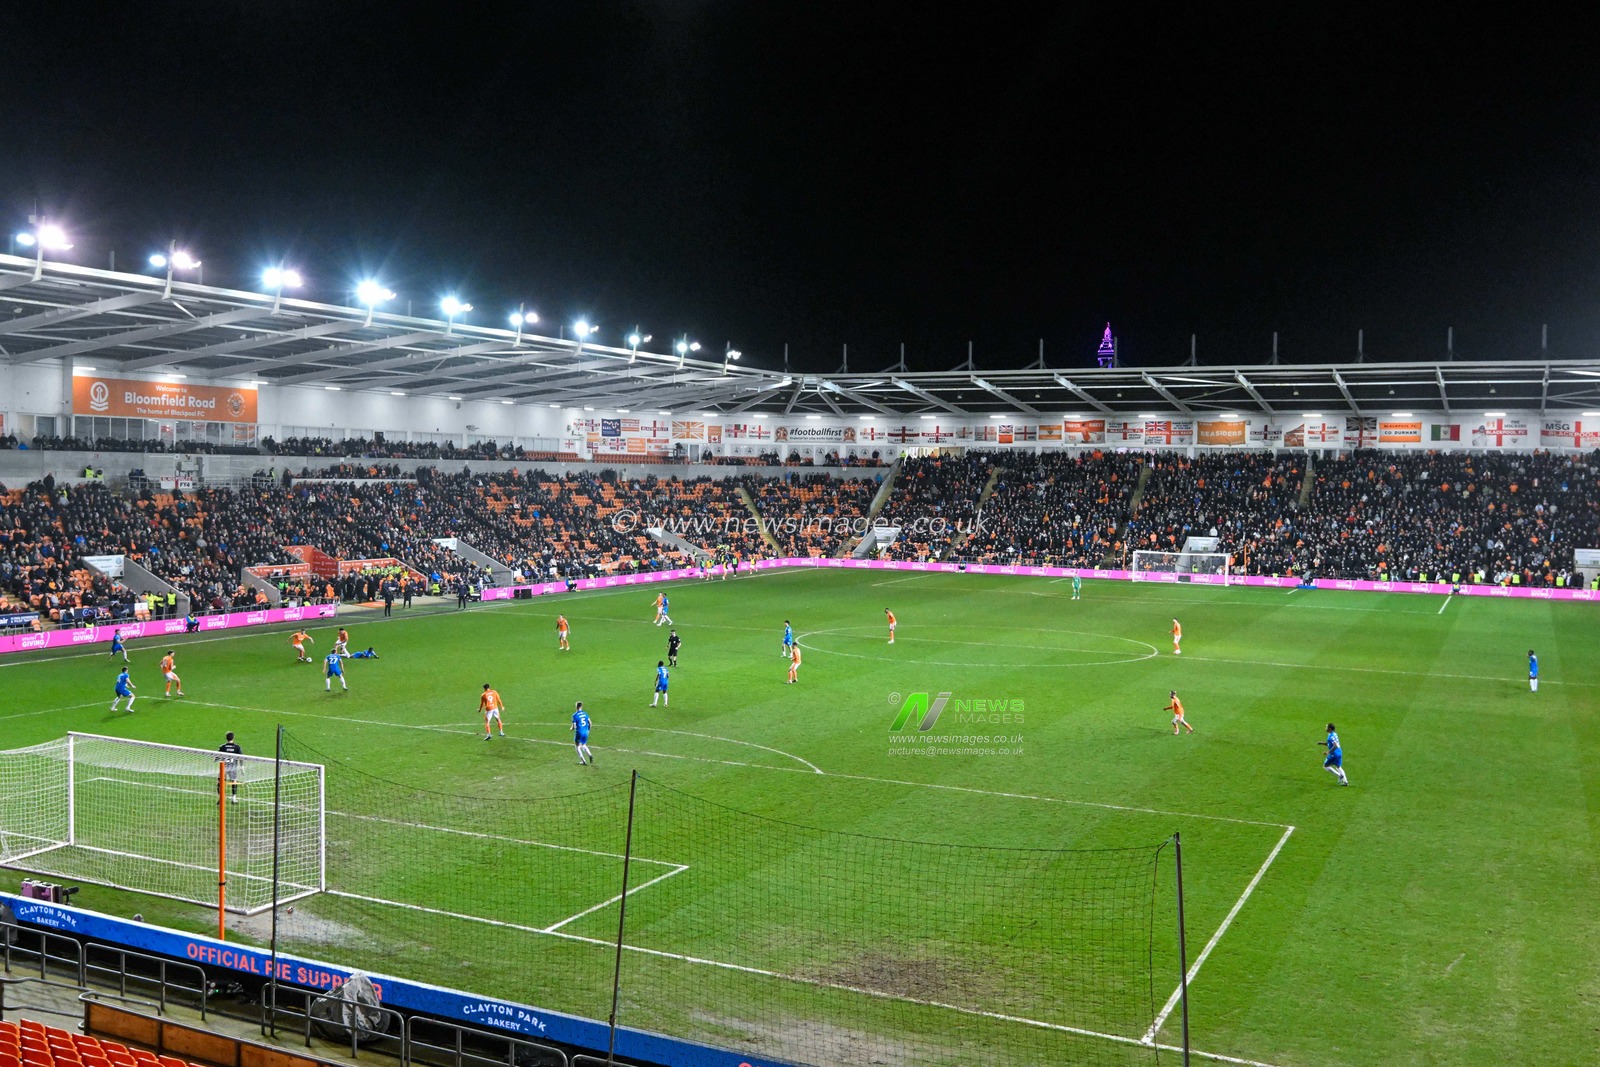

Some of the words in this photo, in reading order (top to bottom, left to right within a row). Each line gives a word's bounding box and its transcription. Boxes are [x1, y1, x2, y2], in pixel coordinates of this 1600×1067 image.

[124, 392, 185, 406] Bloomfield
[188, 396, 216, 408] Road
[171, 409, 196, 417] Blackpool
[790, 428, 842, 436] #footballfirst
[581, 718, 586, 727] 5
[20, 906, 54, 915] CLAYTON
[57, 911, 77, 927] PARK
[37, 916, 59, 927] BAKERY
[187, 943, 260, 973] OFFICIAL
[266, 960, 291, 980] PIE
[298, 967, 382, 1000] SUPPR
[463, 1004, 512, 1016] CLAYTON
[518, 1011, 547, 1032] PARK
[488, 1017, 520, 1031] BAKERY
